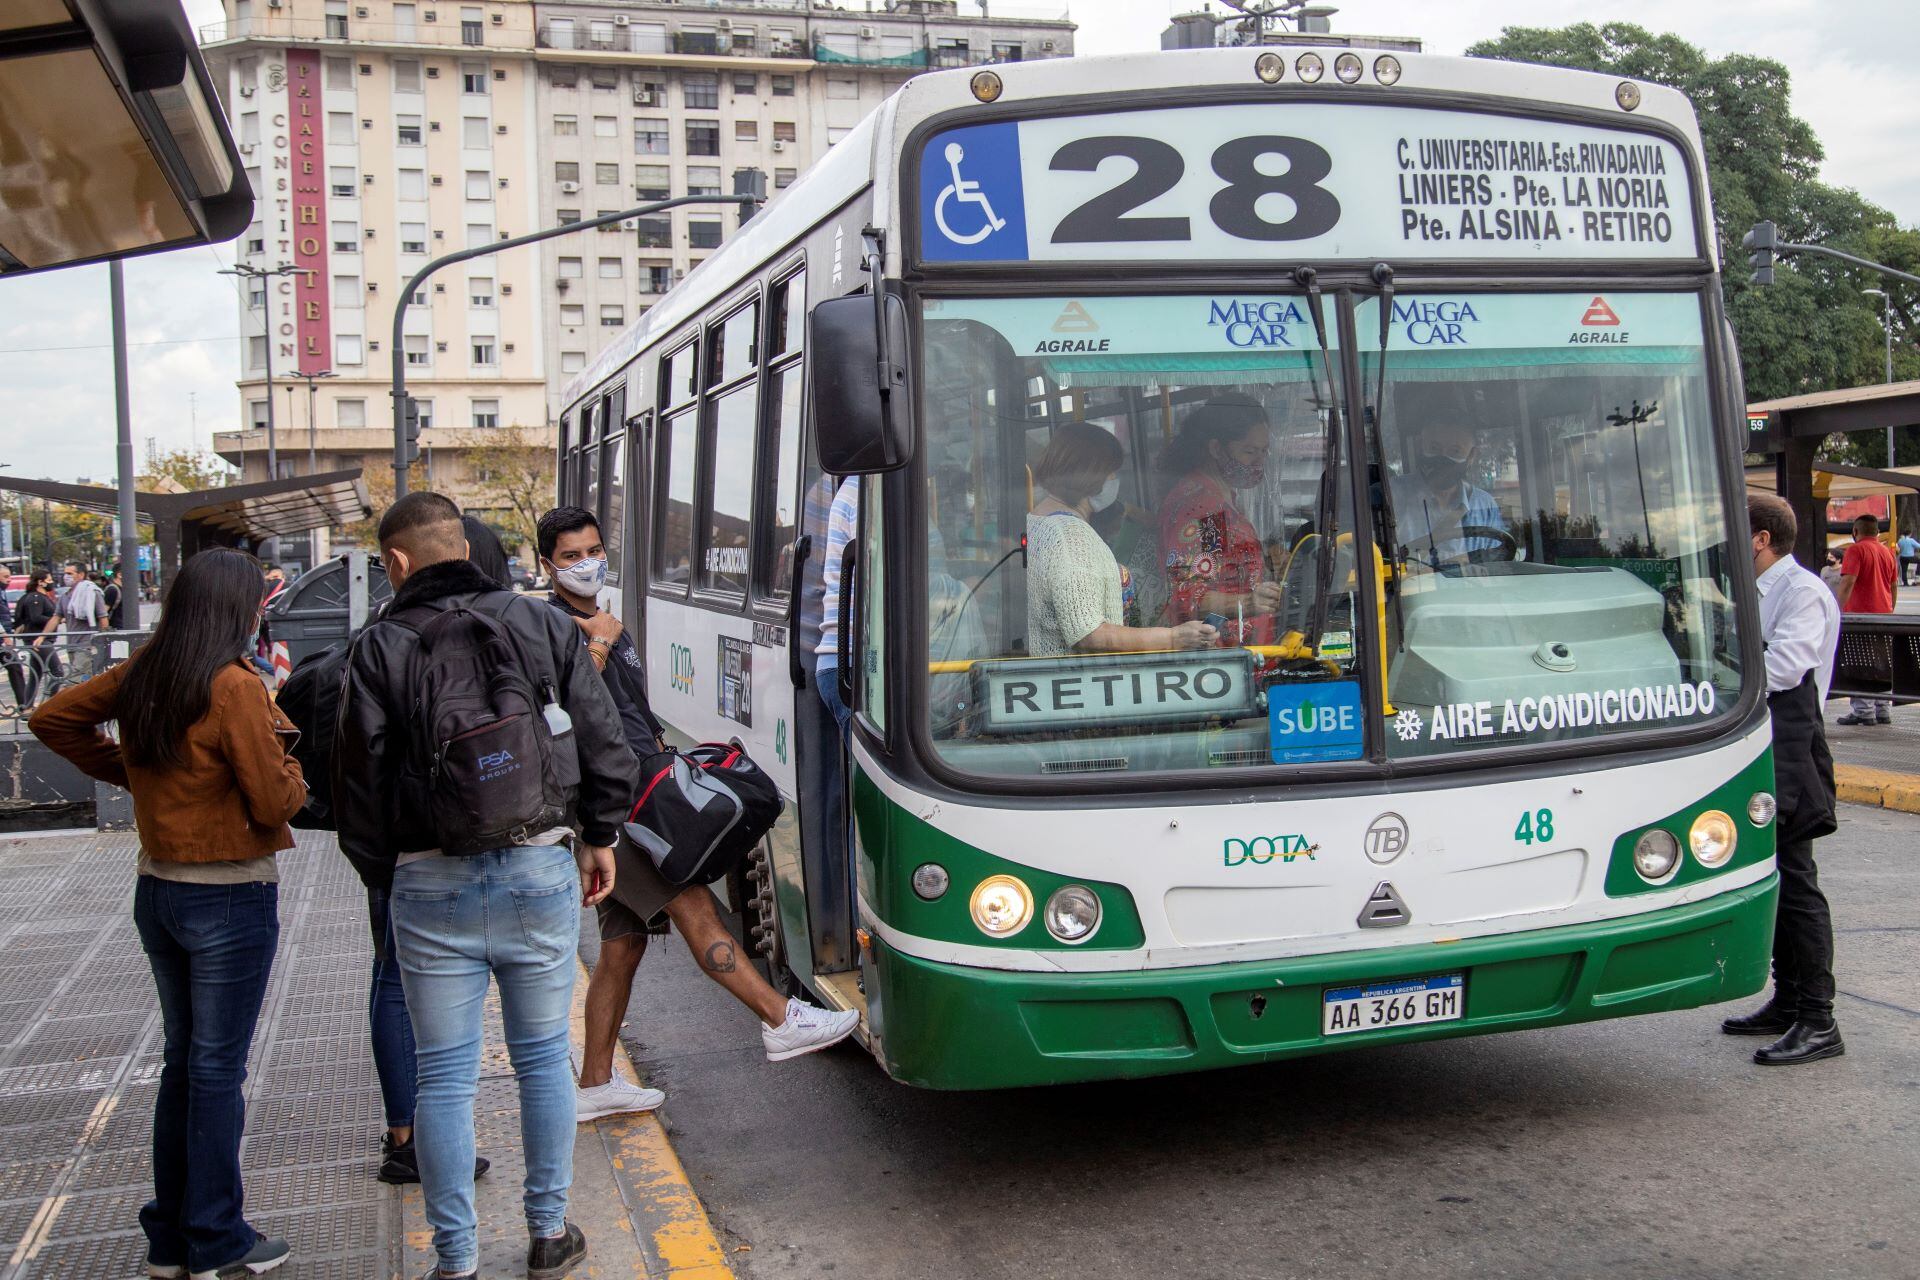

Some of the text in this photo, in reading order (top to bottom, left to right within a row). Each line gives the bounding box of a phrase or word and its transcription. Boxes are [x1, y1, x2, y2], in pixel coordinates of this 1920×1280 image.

[1397, 137, 1415, 170] C.
[1048, 134, 1342, 244] 28
[1398, 173, 1493, 206] LINIERS
[1513, 175, 1556, 207] Pte.
[1562, 176, 1592, 207] LA
[1597, 177, 1670, 209] NORIA
[297, 63, 322, 355] PALACE HOTEL
[1402, 208, 1451, 241] Pte.
[1459, 208, 1562, 241] ALSINA
[1582, 211, 1672, 243] RETIRO
[272, 114, 295, 357] CONSTITCION
[1207, 299, 1305, 325] MEGA
[1391, 299, 1481, 323] MEGA
[1034, 338, 1111, 353] AGRALE
[1225, 322, 1294, 347] CAR
[1406, 321, 1468, 345] CAR
[1568, 332, 1630, 344] AGRALE
[1750, 419, 1764, 431] 59
[741, 670, 751, 715] 28
[1003, 667, 1232, 714] RETIRO
[1278, 705, 1355, 735] SUBE
[1429, 680, 1715, 741] AIRE ACONDICIONADO
[775, 718, 787, 766] 48
[478, 750, 515, 769] PSA
[1514, 808, 1554, 846] 48
[1223, 833, 1318, 867] DOTA
[1394, 984, 1427, 993] ARGENTINA
[1331, 990, 1456, 1029] AA 366 GM
